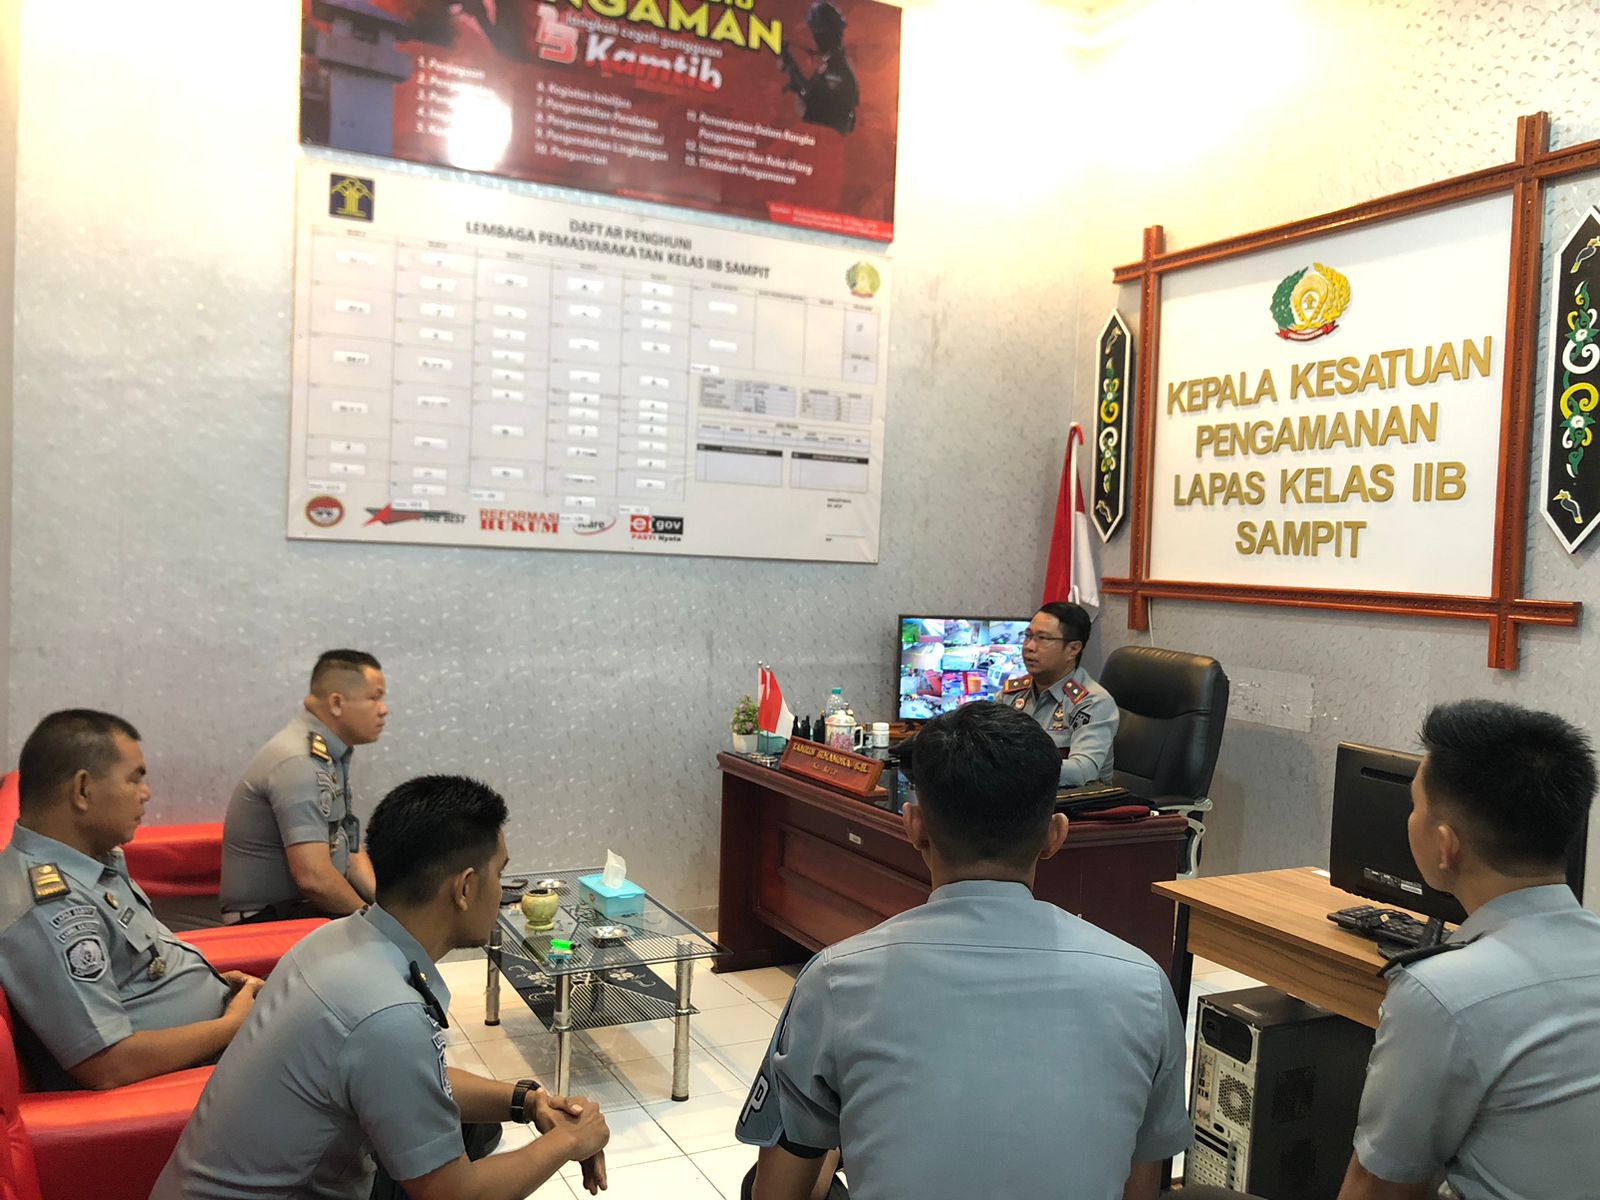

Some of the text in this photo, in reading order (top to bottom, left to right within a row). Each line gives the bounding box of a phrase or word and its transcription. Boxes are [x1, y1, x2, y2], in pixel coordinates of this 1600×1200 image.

[548, 0, 782, 55] GAMAN
[466, 221, 536, 243] LEMBAGA
[667, 251, 704, 269] KELAS
[707, 257, 723, 272] IIB
[725, 261, 770, 279] SAMPIT
[624, 228, 692, 250] PENGHUNI
[1167, 336, 1492, 415] KEPALA KESATUAN
[1196, 402, 1438, 458] PENGAMANAN
[1174, 462, 1466, 506] LAPAS KELAS IIB
[480, 508, 560, 523] REFORMASI
[480, 519, 559, 534] HUKUM
[656, 520, 682, 532] gov
[1236, 520, 1366, 558] SAMPIT
